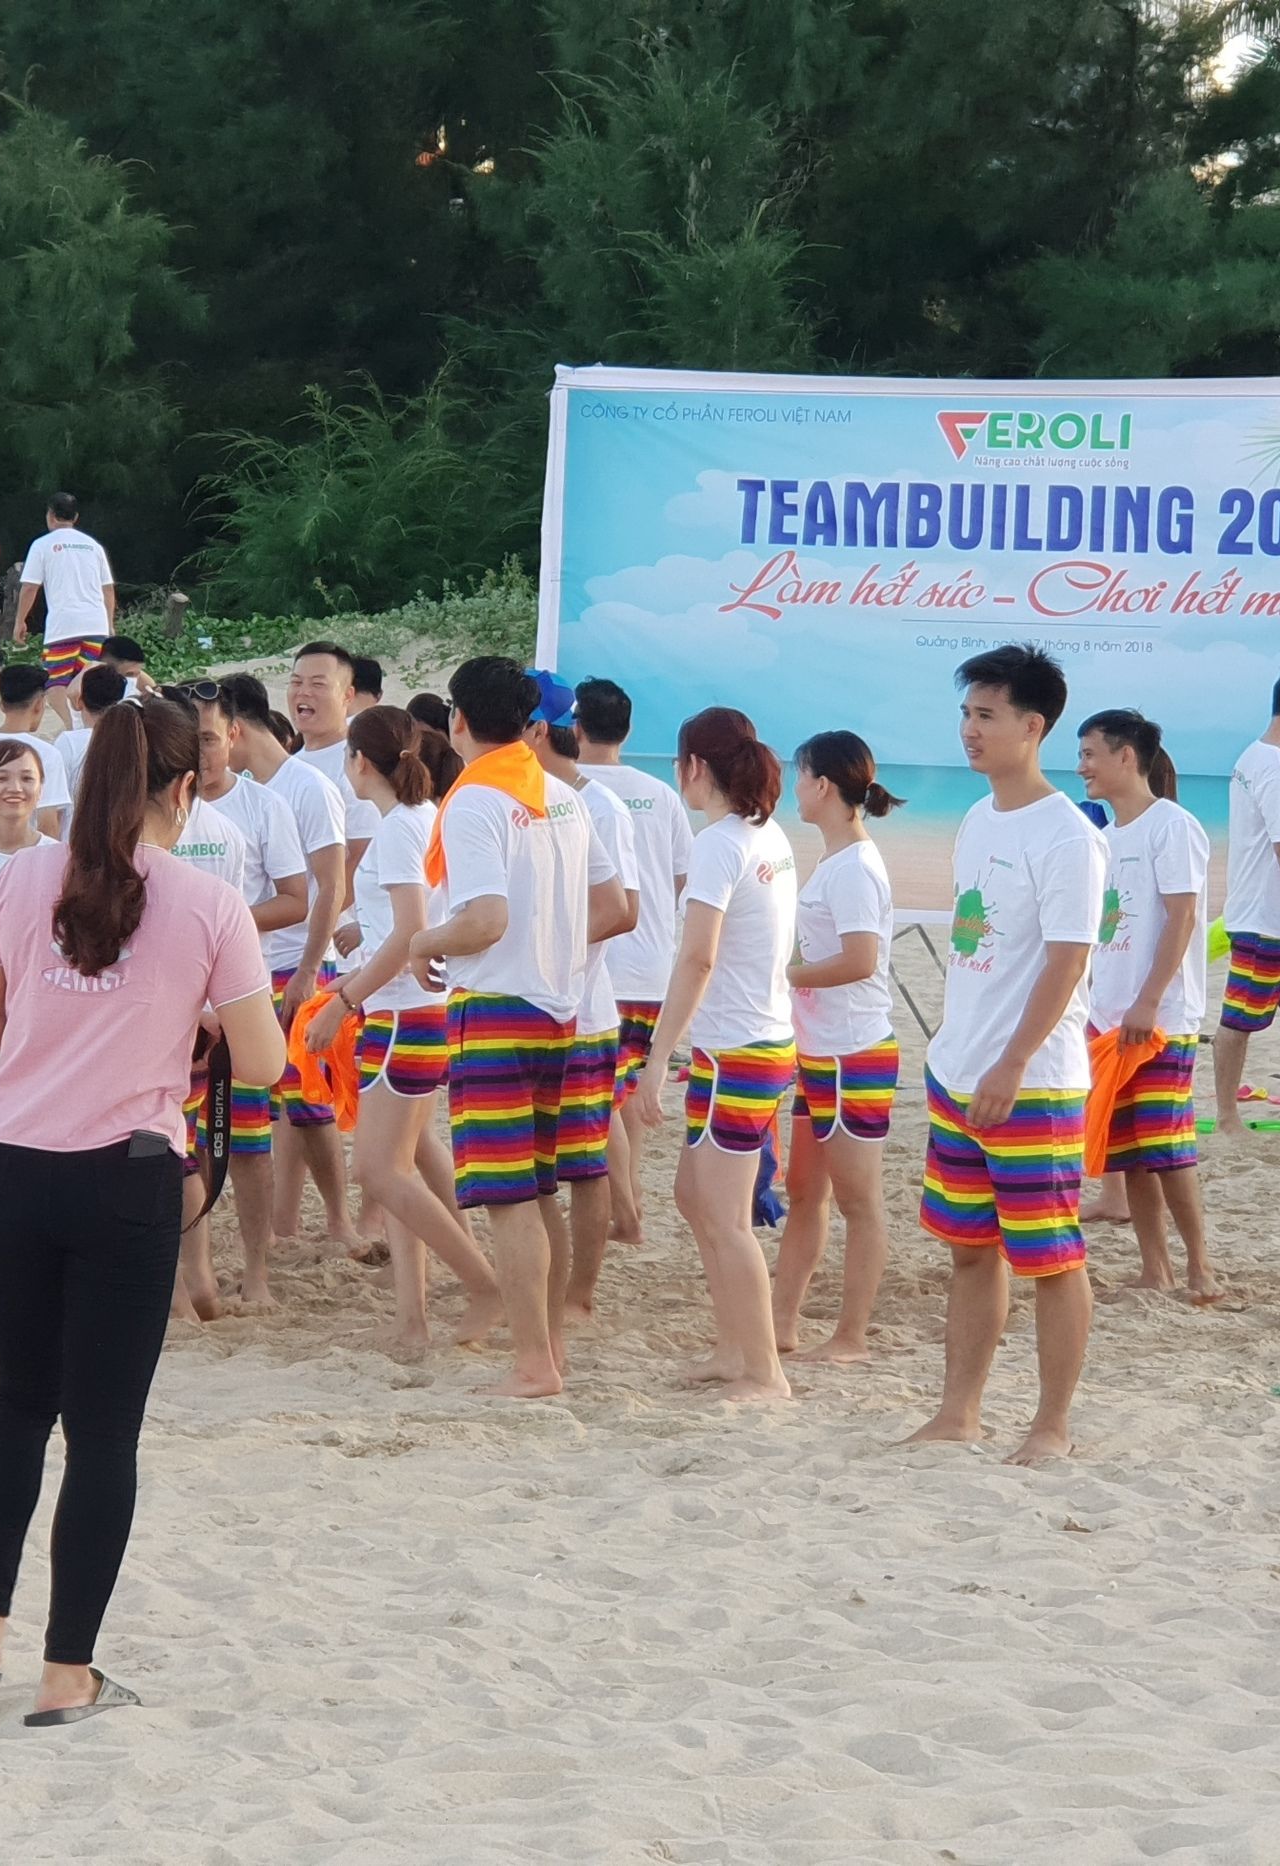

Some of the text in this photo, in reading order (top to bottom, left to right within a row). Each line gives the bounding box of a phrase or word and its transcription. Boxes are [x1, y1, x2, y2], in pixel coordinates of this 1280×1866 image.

[580, 403, 629, 420] CÔNG
[633, 406, 648, 420] TY
[652, 401, 679, 421] CỔ
[728, 408, 777, 422] FEROLI
[781, 406, 810, 424] VIỆT
[814, 409, 852, 423] NAM
[936, 411, 1132, 461] FEROLI
[974, 456, 1000, 469] Nâng
[1003, 458, 1020, 467] cao
[736, 479, 1197, 555] TEAMBUILDING
[718, 551, 842, 620] Làm
[848, 560, 921, 607] hết
[912, 569, 987, 609] sức
[1027, 560, 1168, 617] Chơi
[1169, 567, 1244, 614] hết
[915, 635, 959, 650] Quảng
[1044, 639, 1081, 653] tháng
[1083, 640, 1091, 652] 8
[1094, 640, 1122, 652] năm
[1124, 640, 1153, 653] 2018
[213, 1079, 225, 1158] EOS DIGITAL
